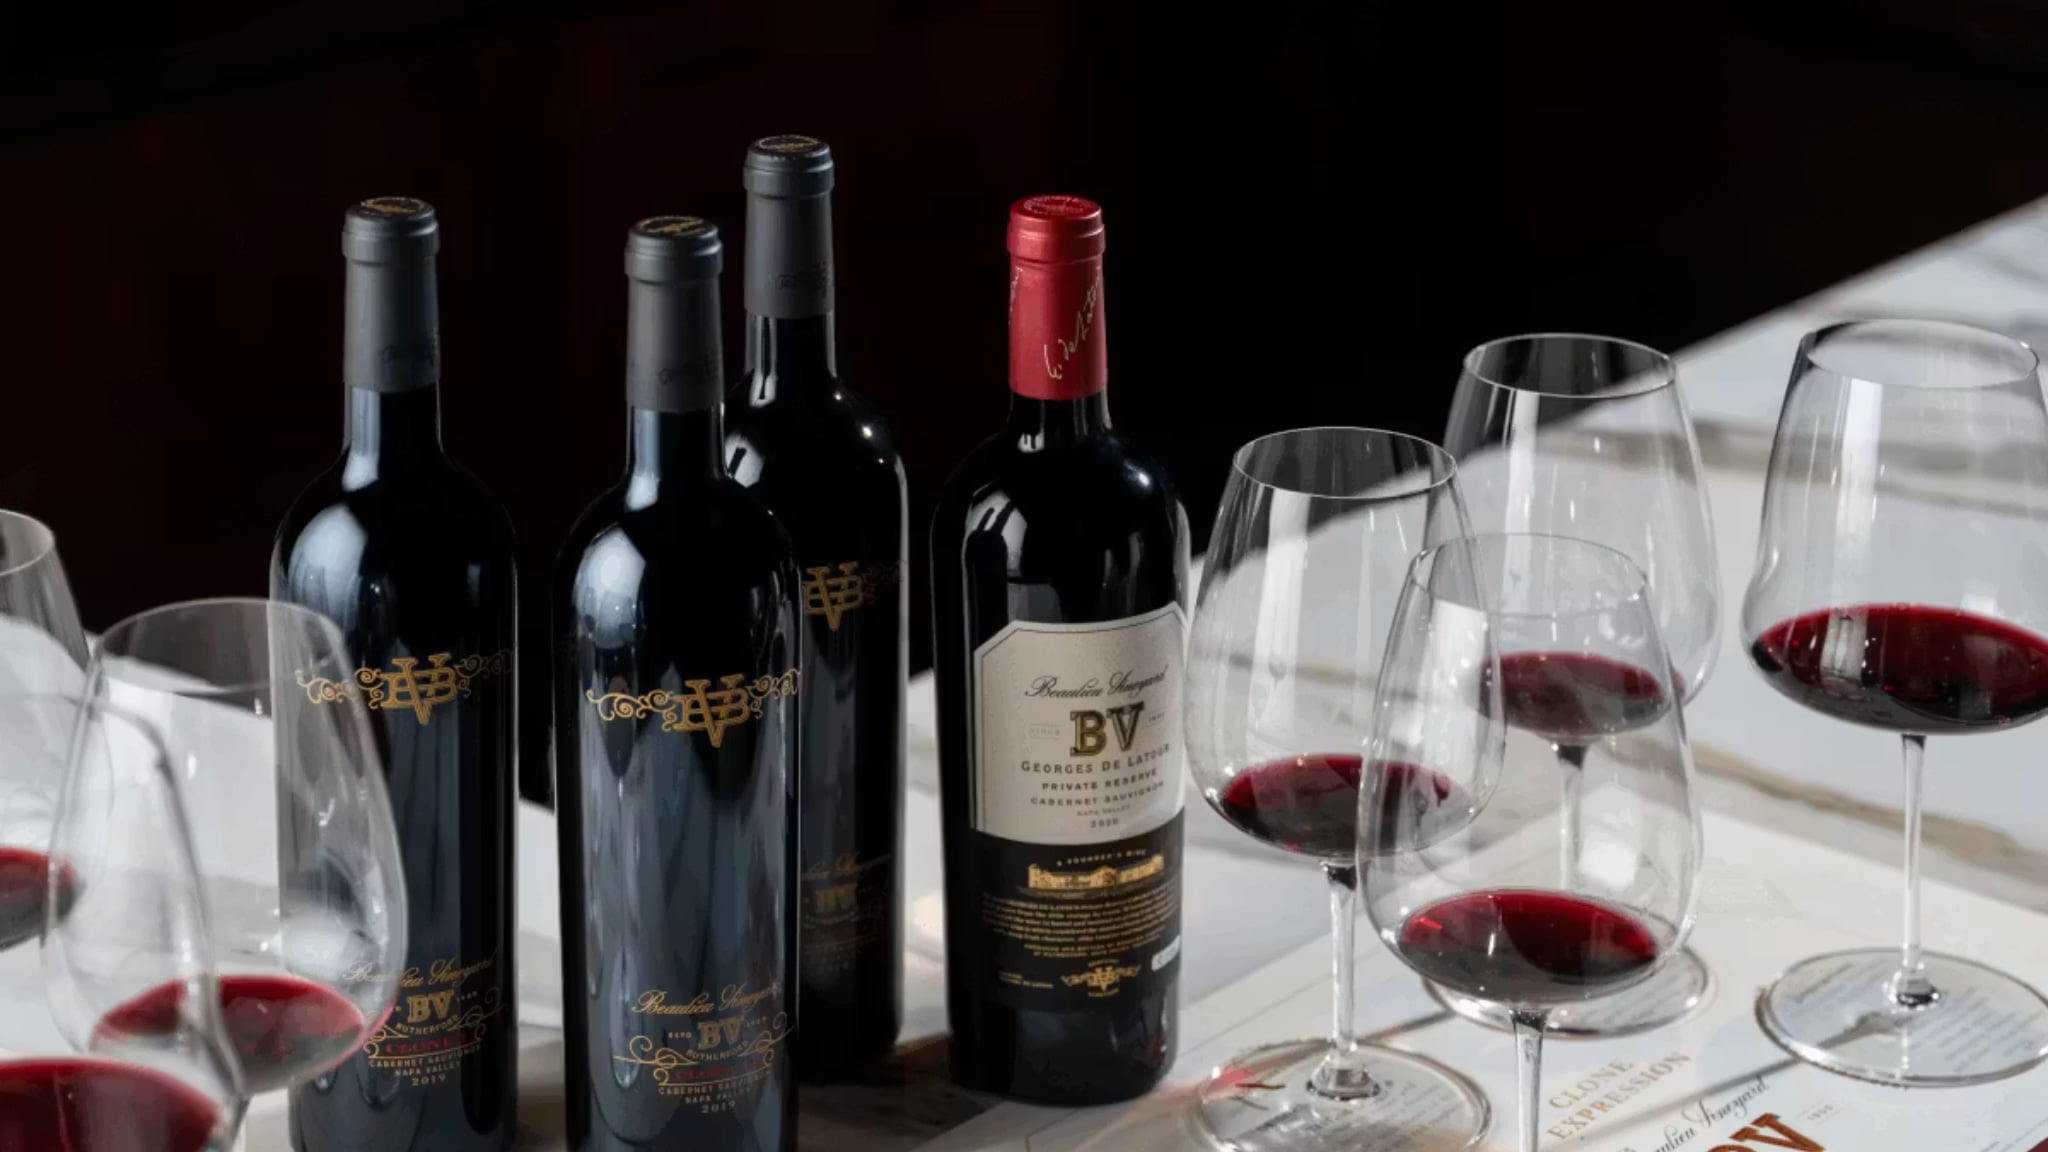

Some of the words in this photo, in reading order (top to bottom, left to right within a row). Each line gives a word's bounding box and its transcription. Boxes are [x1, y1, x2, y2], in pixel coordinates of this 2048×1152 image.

[1025, 675, 1103, 698] Beaulieu
[1107, 664, 1170, 698] Vineyard
[1069, 701, 1145, 757] BV
[1020, 760, 1094, 775] GEORGES
[1102, 759, 1121, 772] DE
[1127, 743, 1170, 768] LATOUR
[1041, 781, 1099, 792] PRIVATE
[1104, 768, 1158, 788] RESERVE
[1030, 796, 1099, 807] CABERNET
[1103, 781, 1165, 804] SAUVIGNON
[1077, 809, 1099, 817] NAPA
[406, 989, 456, 1023] BV
[631, 988, 716, 1016] Beaulieu
[697, 1014, 745, 1050] BV
[368, 1057, 424, 1069] CABERNET
[395, 1067, 422, 1078] NAPA
[411, 1073, 447, 1087] 2019
[658, 1084, 713, 1096] CABERNET
[1549, 1058, 1635, 1110] CLONE
[684, 1096, 712, 1105] NAPA
[701, 1101, 737, 1114] 2019
[1546, 1051, 1692, 1140] EXPRESSION
[1681, 1073, 1770, 1128] Vineyard
